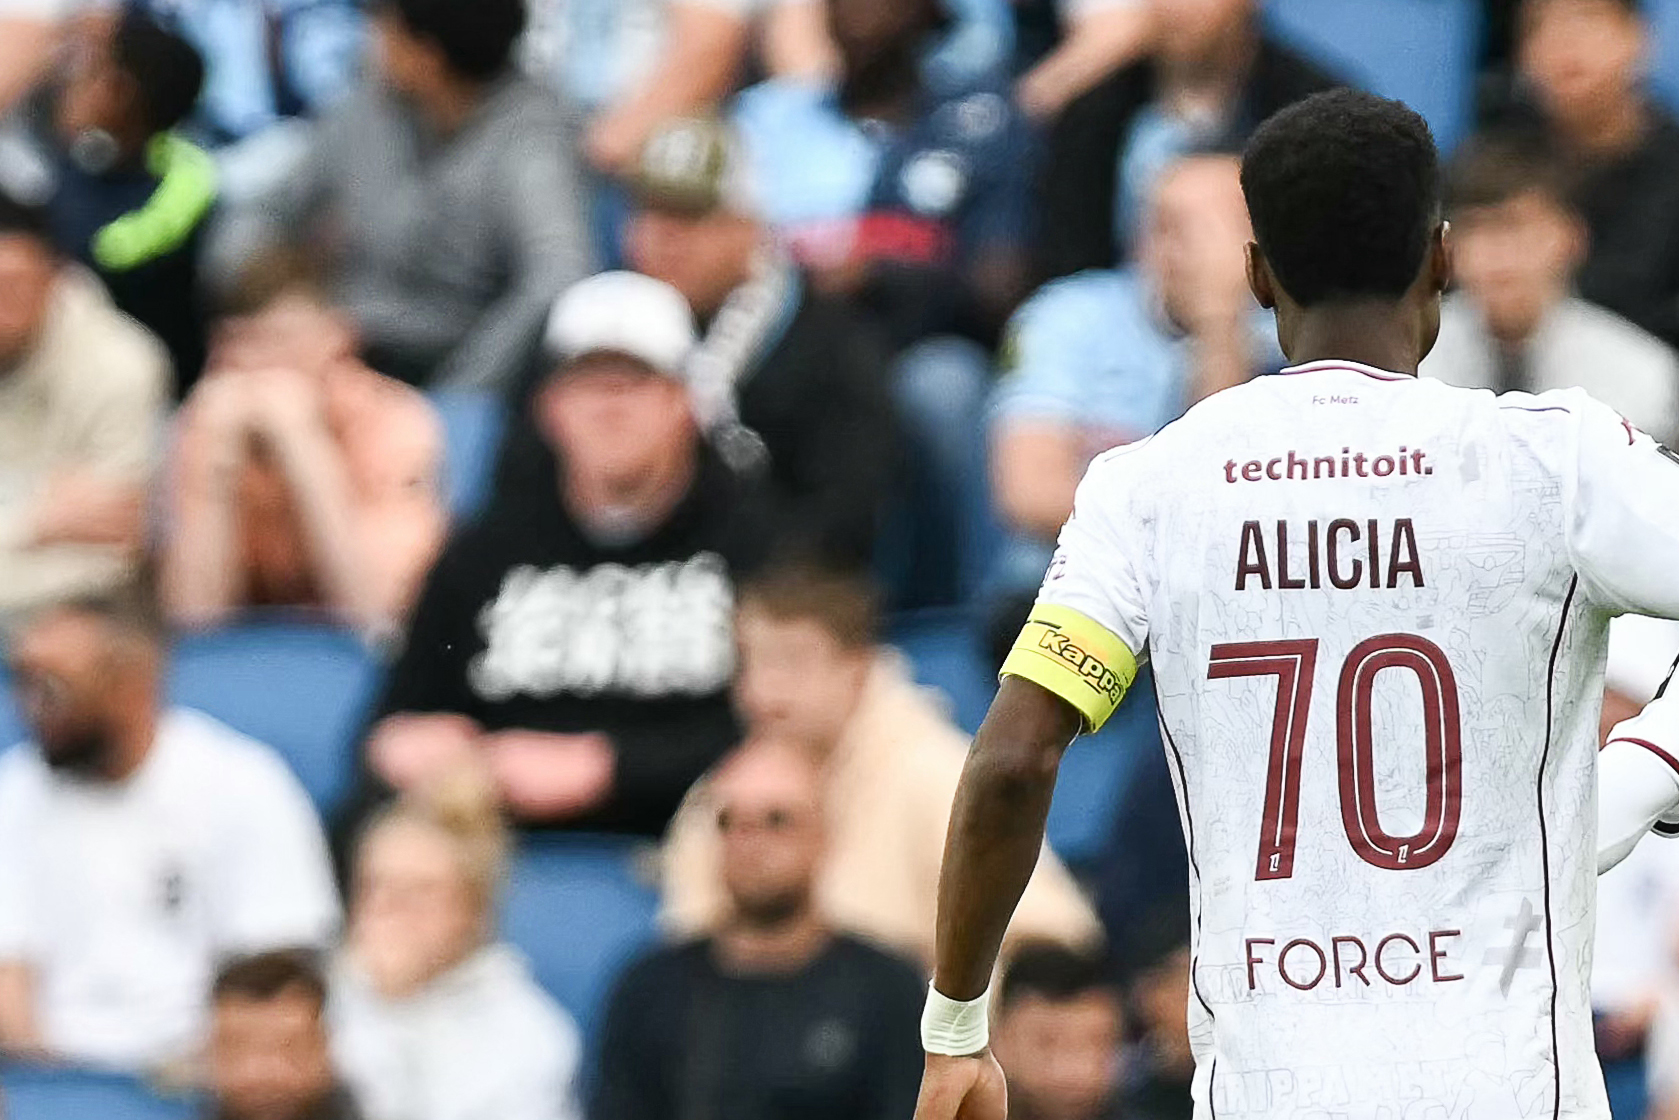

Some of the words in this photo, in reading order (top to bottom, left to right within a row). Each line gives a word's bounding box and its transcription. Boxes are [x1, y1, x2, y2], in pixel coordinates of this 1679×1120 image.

[1235, 517, 1425, 591] ALICIA
[1038, 629, 1126, 705] Kappa
[1207, 633, 1463, 881] 70
[1245, 929, 1464, 990] FORCE
